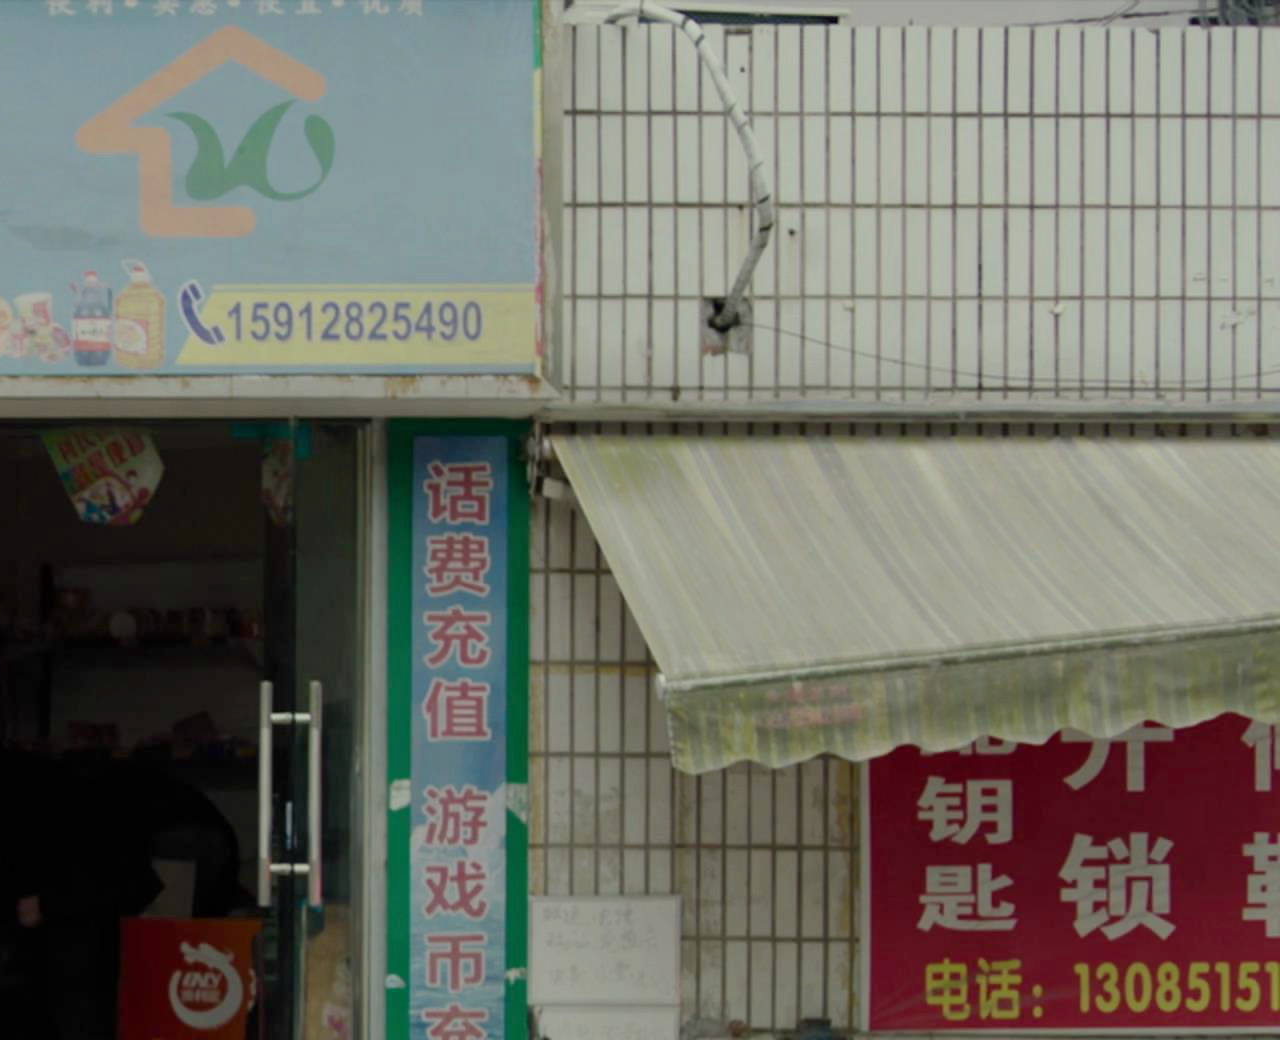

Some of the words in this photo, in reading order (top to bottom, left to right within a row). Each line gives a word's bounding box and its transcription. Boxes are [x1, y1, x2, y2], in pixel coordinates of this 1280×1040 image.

[226, 300, 484, 344] 15912825490
[423, 461, 493, 741] 话费充值
[917, 734, 1018, 932] 钥匙
[1073, 963, 1280, 1013] 13085151
